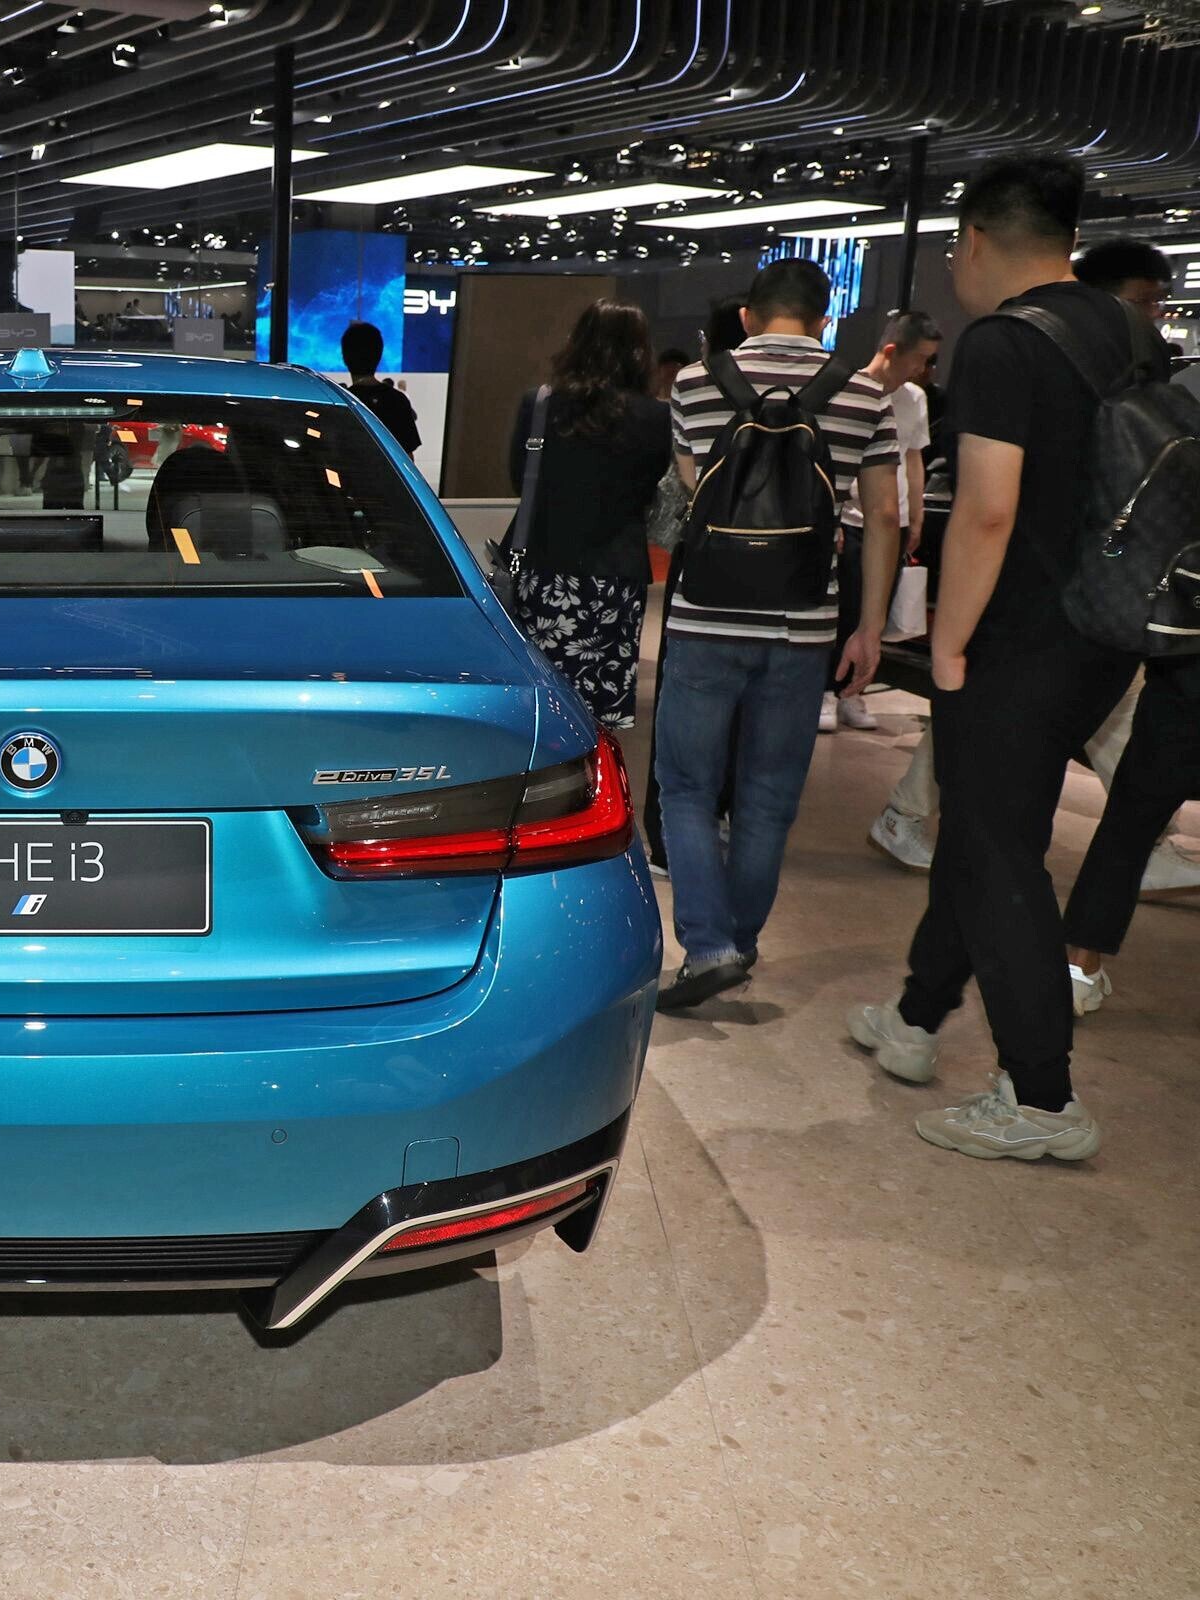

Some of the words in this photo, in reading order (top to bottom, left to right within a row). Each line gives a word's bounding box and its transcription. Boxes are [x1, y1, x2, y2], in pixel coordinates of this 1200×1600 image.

[403, 289, 456, 315] BY
[185, 331, 214, 342] BYD
[6, 738, 53, 756] BMW
[397, 765, 451, 782] 35L
[70, 842, 105, 882] i3
